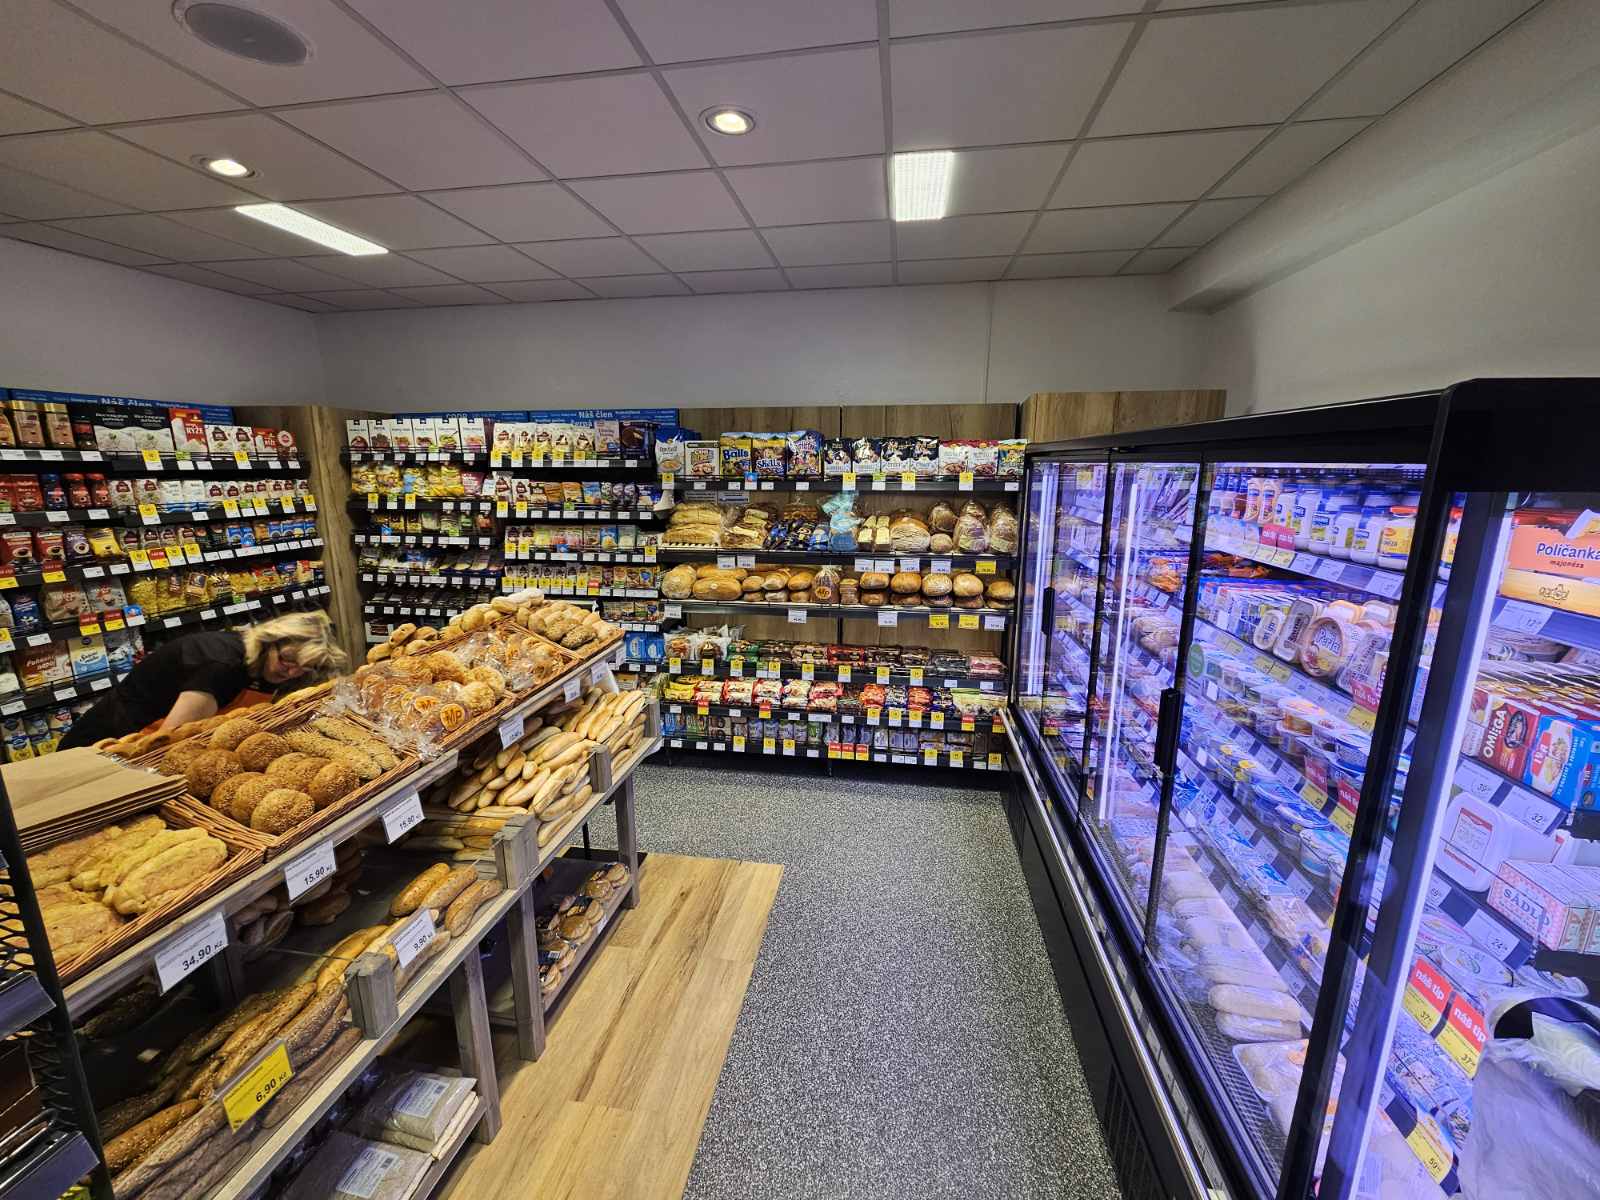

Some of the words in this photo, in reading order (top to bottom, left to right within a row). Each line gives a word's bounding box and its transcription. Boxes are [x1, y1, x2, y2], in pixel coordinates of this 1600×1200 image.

[723, 448, 749, 460] Balls
[755, 458, 782, 468] Shells
[182, 944, 211, 971] 34,90
[1415, 970, 1433, 989] náš
[1432, 983, 1444, 1000] tip
[1454, 1007, 1473, 1029] náš
[1472, 1024, 1486, 1043] tip
[255, 1078, 277, 1103] 6,90
